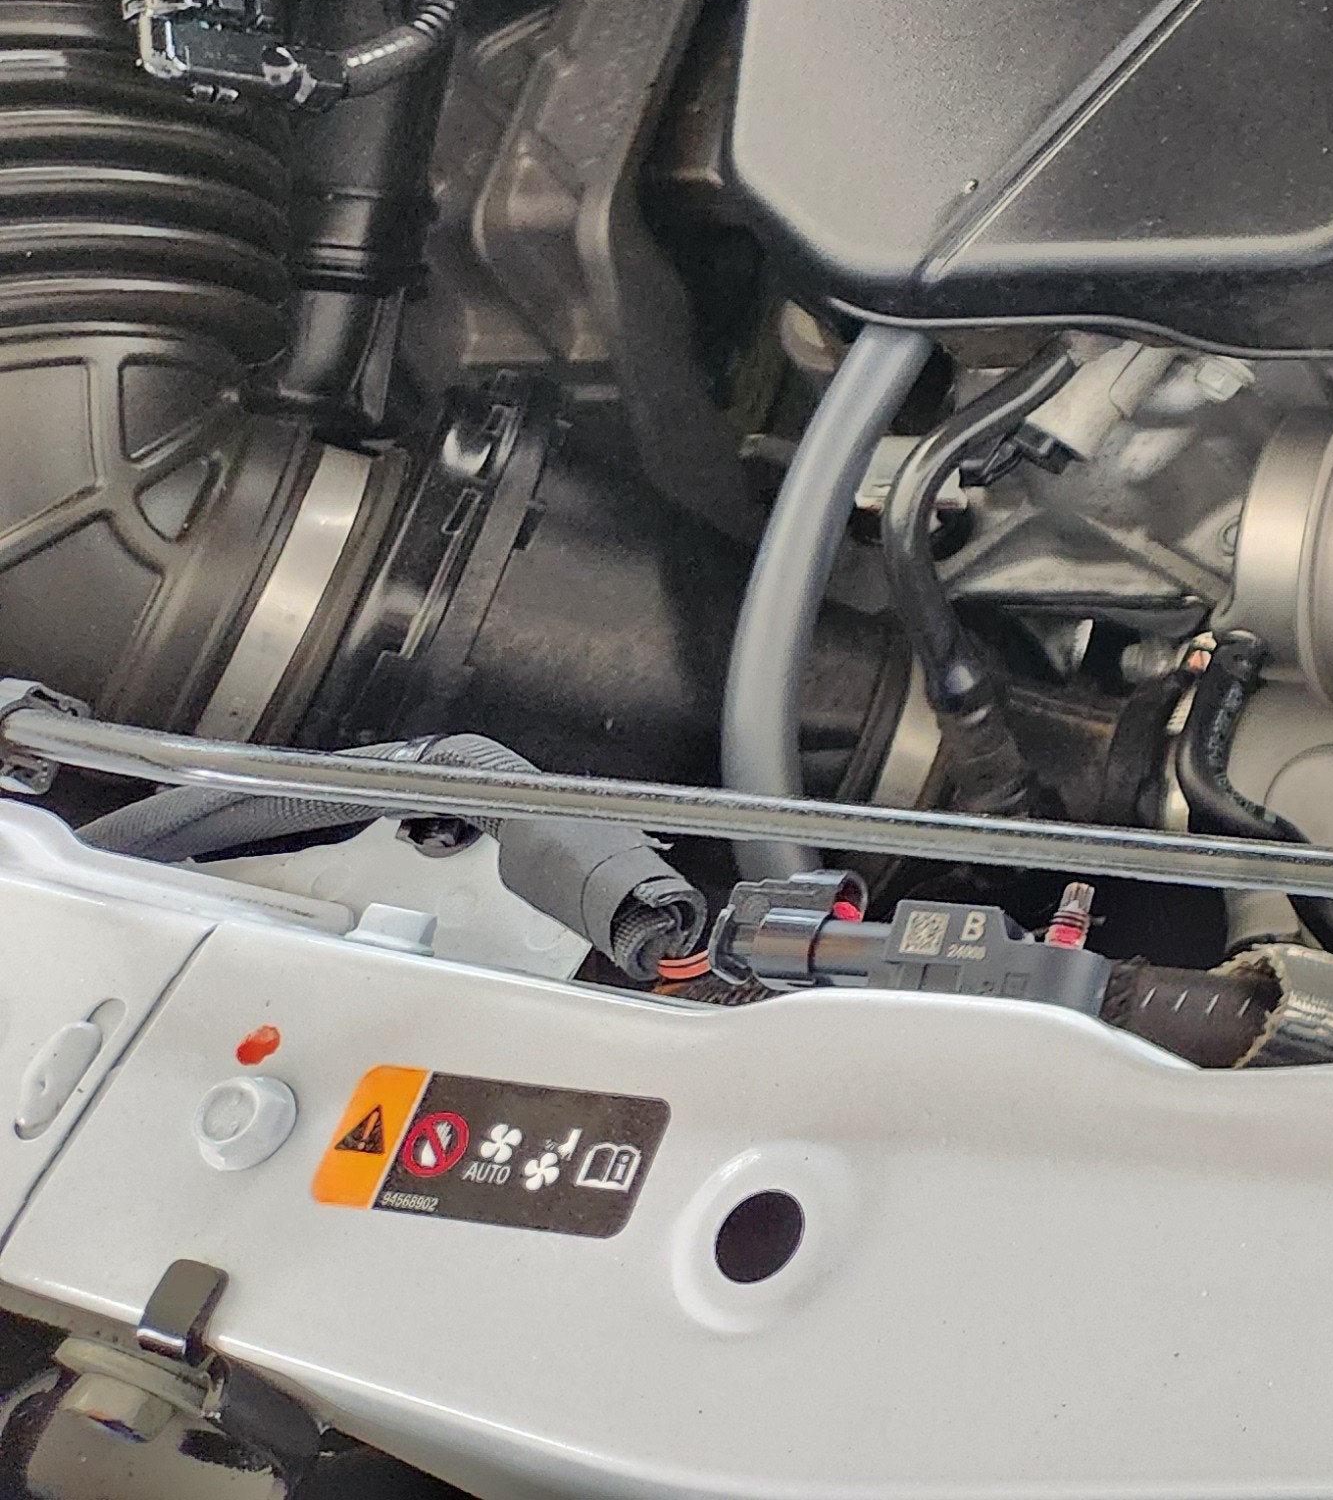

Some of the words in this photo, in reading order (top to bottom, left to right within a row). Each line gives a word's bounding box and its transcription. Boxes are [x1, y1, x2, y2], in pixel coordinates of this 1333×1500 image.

[960, 909, 988, 942] B
[461, 1161, 512, 1186] AUTO
[381, 1191, 439, 1212] 94568902
